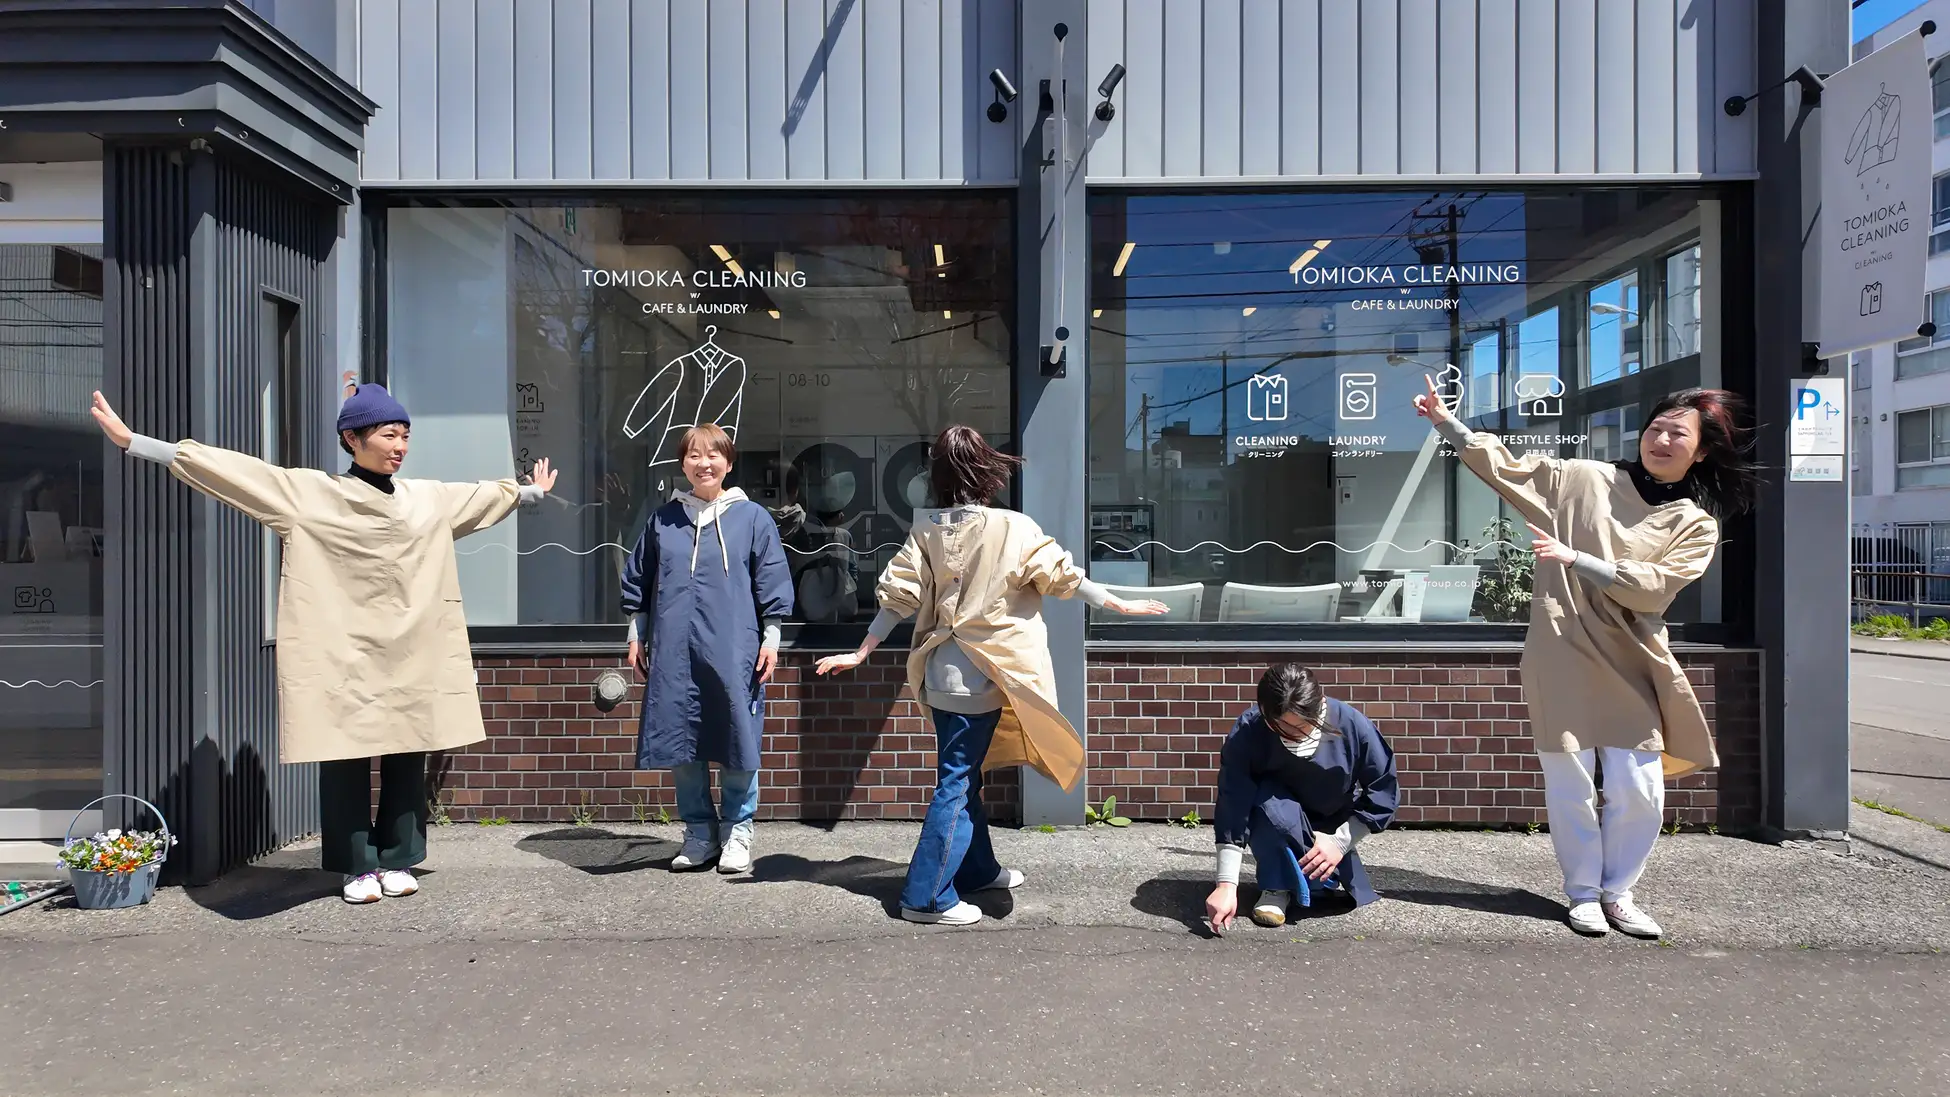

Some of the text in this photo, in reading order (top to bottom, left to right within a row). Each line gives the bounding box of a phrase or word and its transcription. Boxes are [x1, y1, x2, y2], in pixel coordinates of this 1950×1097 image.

[1844, 200, 1907, 232] TOMIOKA
[1840, 218, 1909, 252] CLEANING
[1854, 251, 1893, 270] CLEANING
[581, 270, 807, 288] TOMIOKA CLEANING
[1290, 265, 1520, 285] TOMIOKA CLEANING
[642, 303, 749, 314] CAFE & LAUNDRY
[1351, 299, 1460, 311] CAFE & LAUNDRY
[788, 373, 831, 387] 08-10
[1797, 388, 1821, 421] P
[1235, 436, 1299, 446] CLEANING
[1328, 436, 1387, 446] LAUNDRY
[1497, 434, 1588, 445] IFESTYLE SHOP
[1247, 450, 1285, 458] クリーニング
[1331, 450, 1383, 458] コインランドリー
[1439, 449, 1459, 457] カフェ
